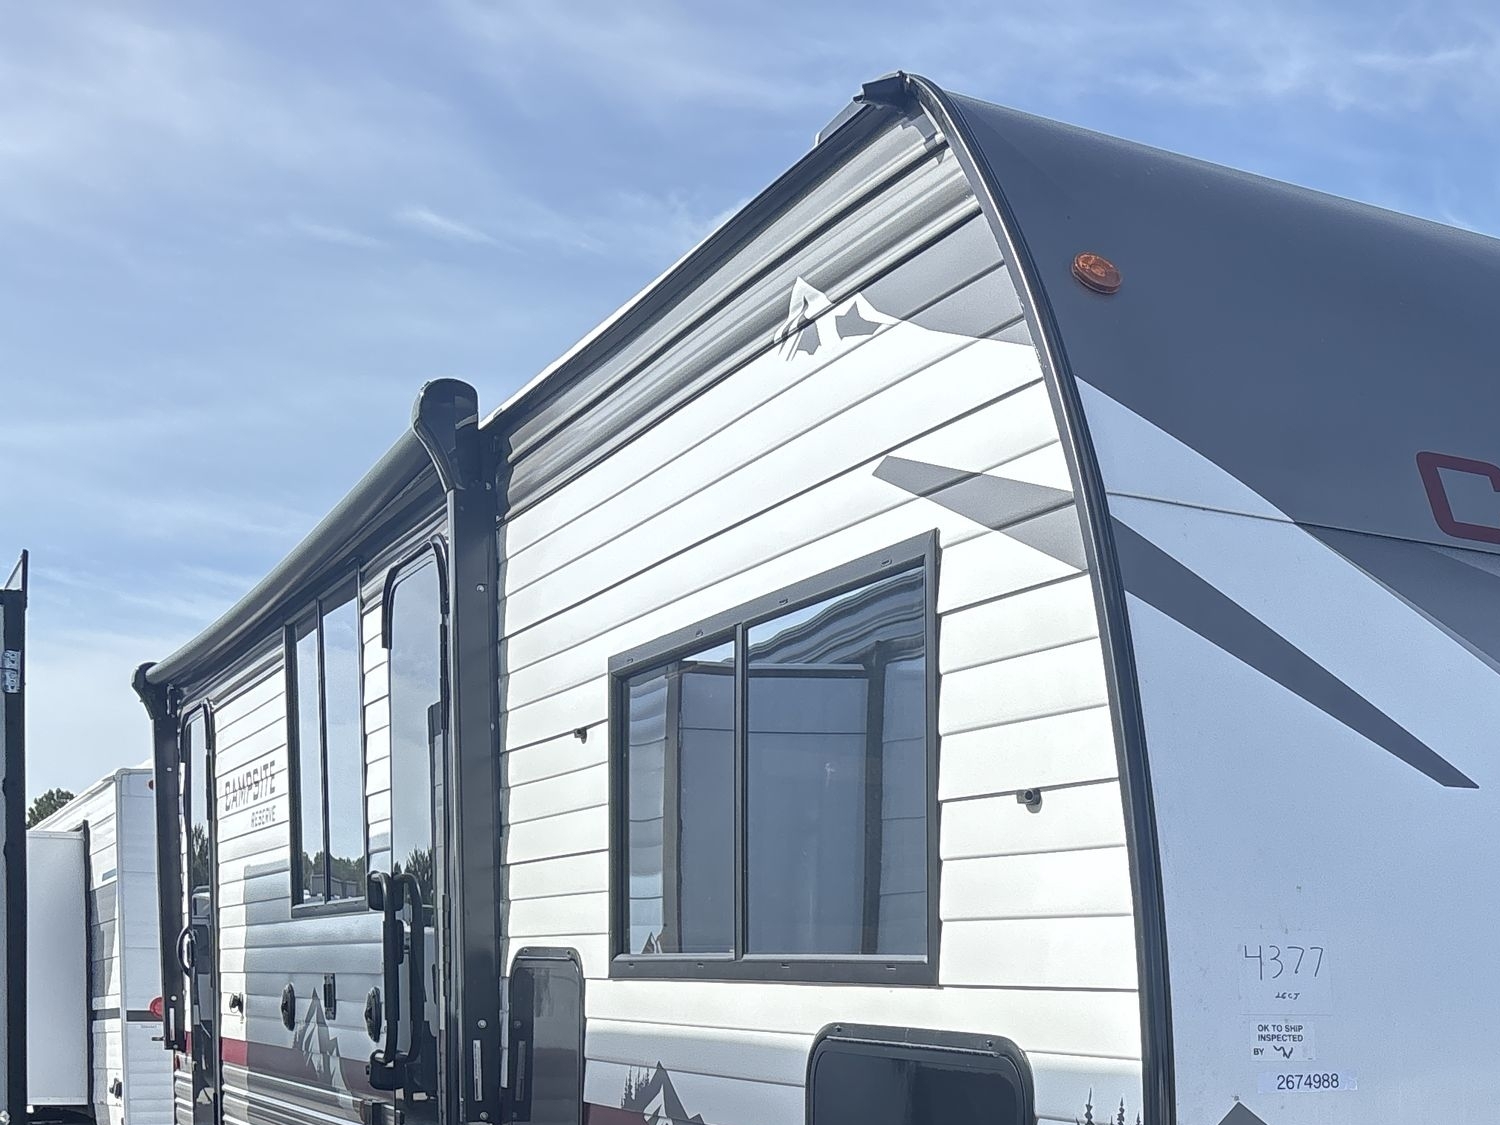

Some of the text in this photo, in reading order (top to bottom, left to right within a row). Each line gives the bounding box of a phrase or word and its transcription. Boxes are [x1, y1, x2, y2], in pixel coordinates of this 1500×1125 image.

[225, 760, 276, 812] CAMPSITE
[1244, 945, 1324, 981] 4377
[1257, 1024, 1304, 1033] OK TO SHIP
[1257, 1034, 1304, 1042] INSPECTED
[1253, 1048, 1265, 1056] BY
[1277, 1073, 1339, 1090] 2674988
